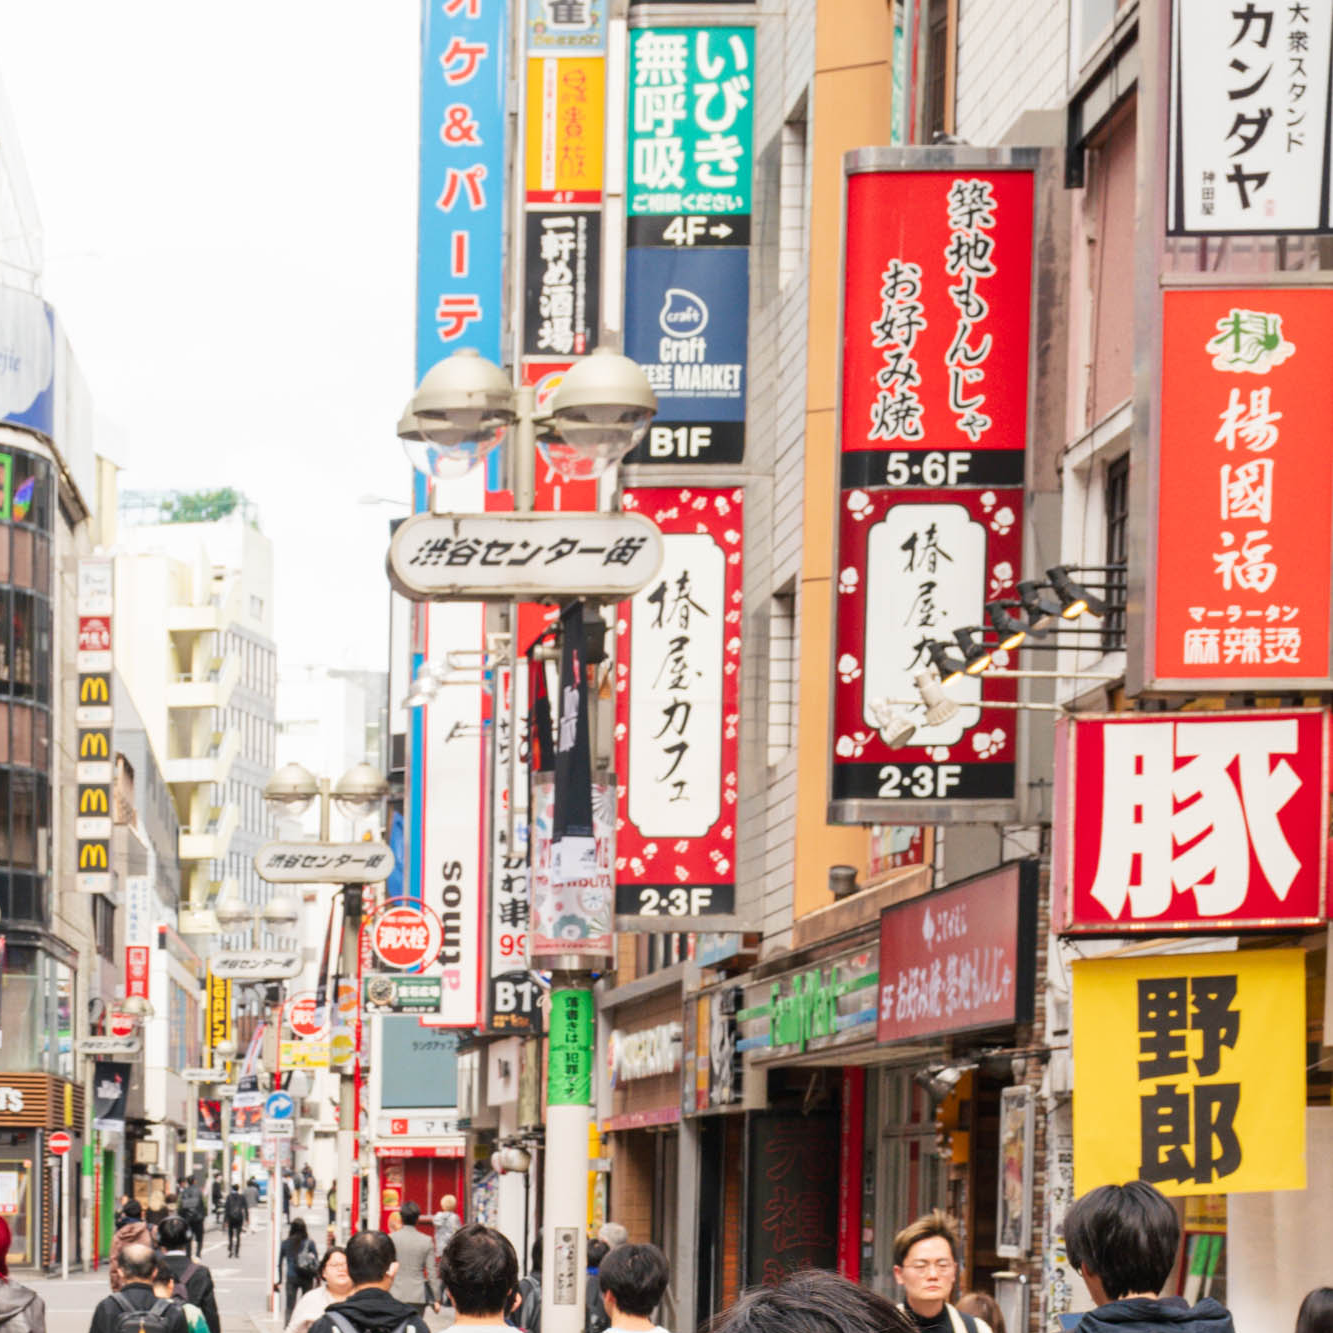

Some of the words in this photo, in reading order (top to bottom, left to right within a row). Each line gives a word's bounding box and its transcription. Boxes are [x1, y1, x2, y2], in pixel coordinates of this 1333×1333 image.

[633, 31, 687, 190] 無呼吸
[694, 31, 750, 188] いびき
[1224, 2, 1274, 210] カンダヤ
[1286, 2, 1310, 153] 大衆スタンド
[436, 0, 487, 340] ケ&パーテ
[663, 216, 707, 245] 4F
[538, 217, 576, 354] 一軒め酒場
[660, 338, 706, 363] Craft
[868, 258, 927, 441] お好み焼
[946, 179, 996, 442] 築地もんじゃ
[650, 427, 711, 457] B1F
[674, 364, 742, 389] MARKET
[409, 537, 647, 566] 渋谷センター街
[1213, 386, 1283, 593] 楊國福
[647, 571, 709, 802] 椿屋カフェ
[1187, 605, 1299, 623] マーラータン
[266, 853, 387, 870] 渋谷センター街
[1089, 719, 1303, 920] 豚
[379, 926, 428, 949] 消火栓
[1137, 974, 1243, 1185] 野郎
